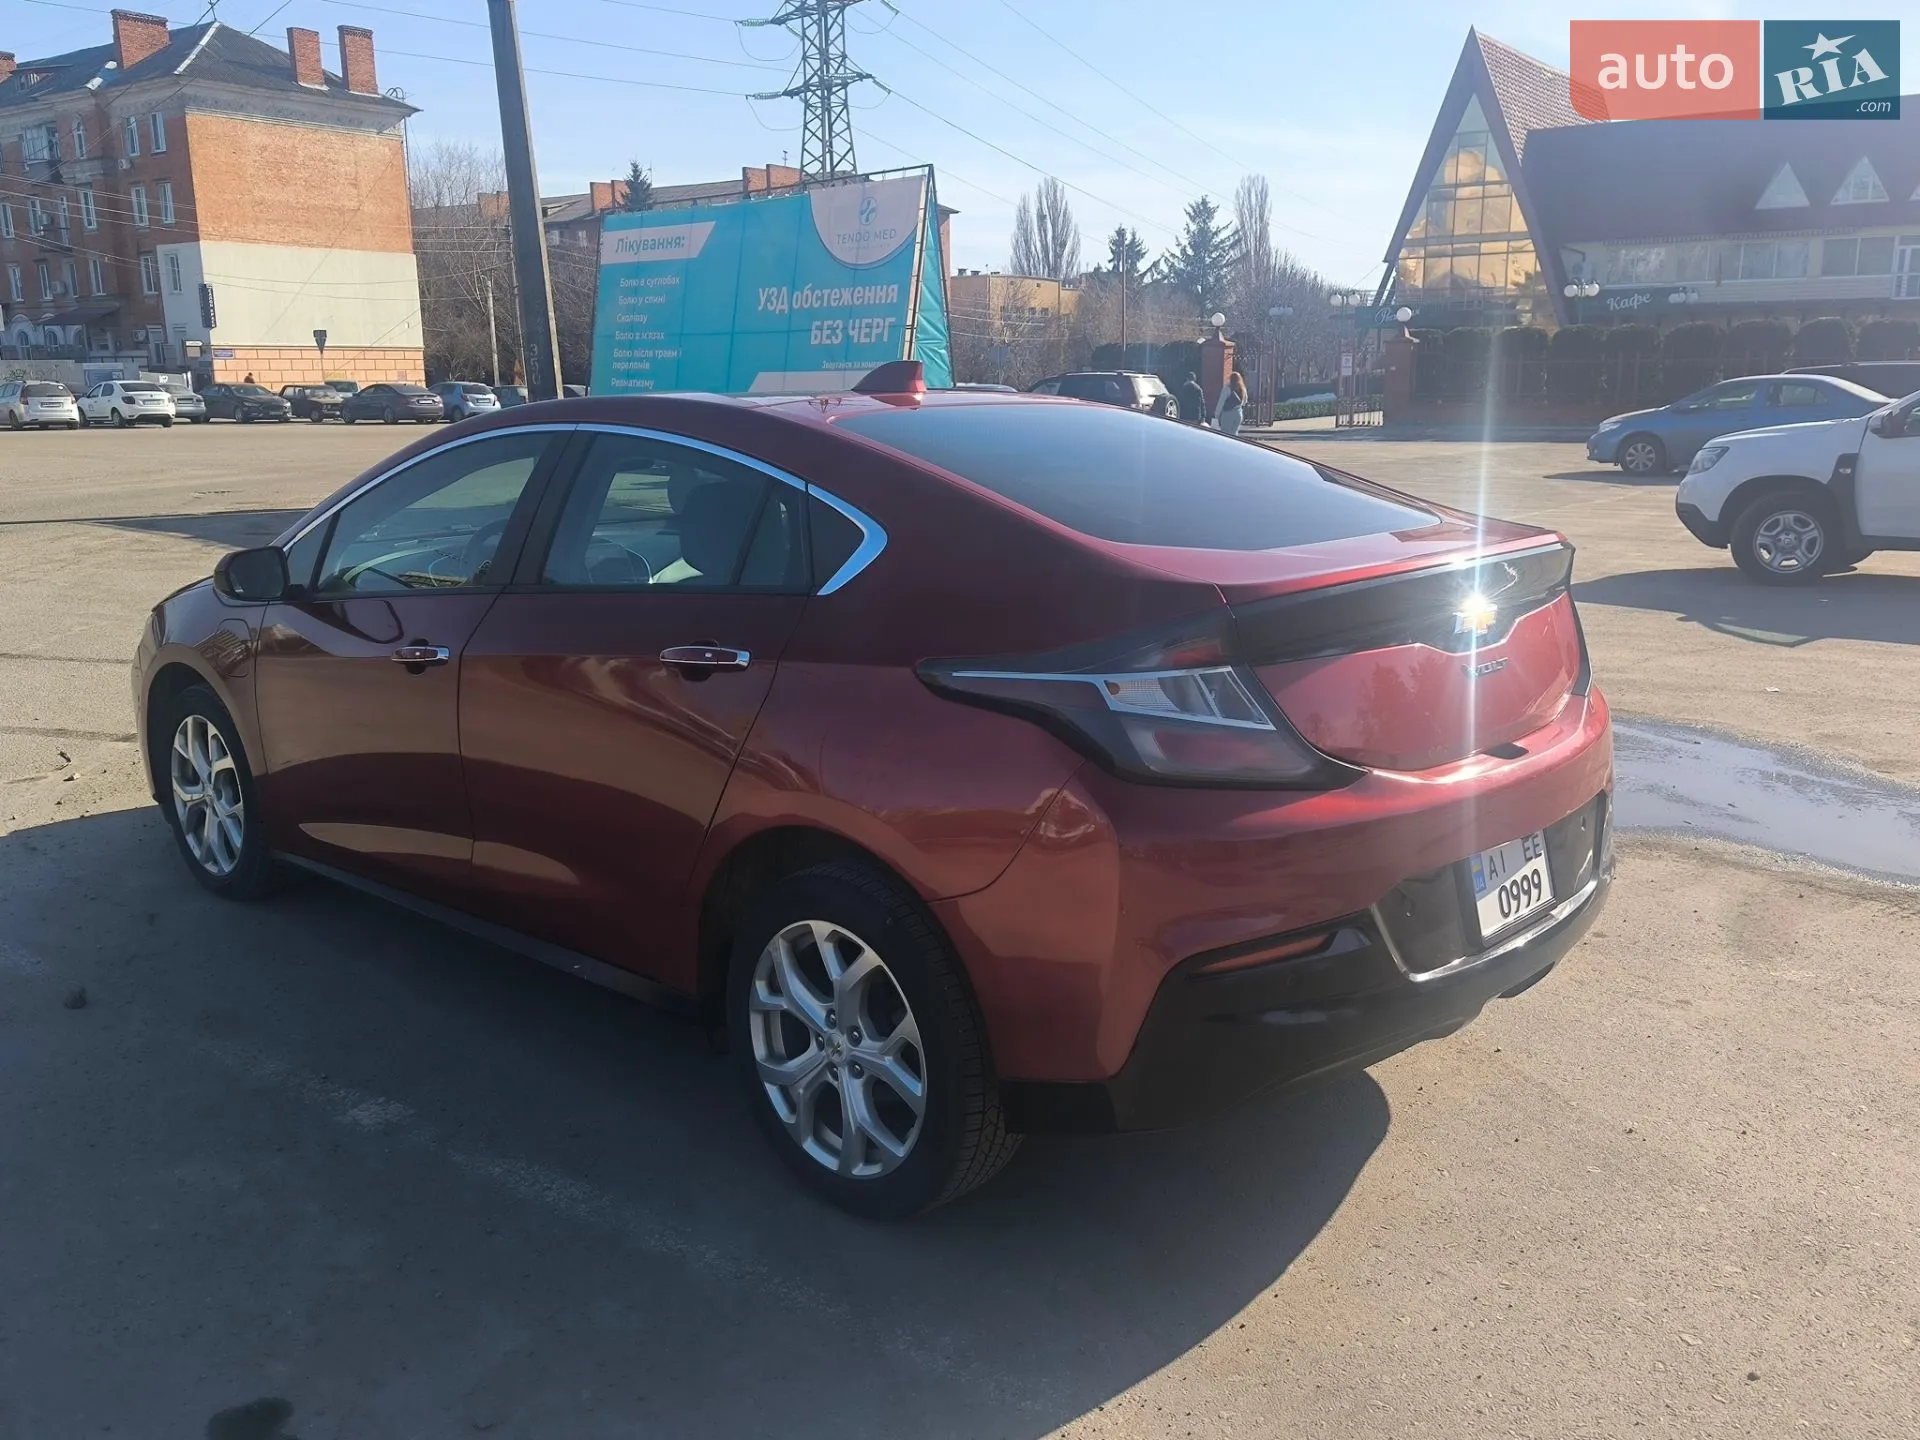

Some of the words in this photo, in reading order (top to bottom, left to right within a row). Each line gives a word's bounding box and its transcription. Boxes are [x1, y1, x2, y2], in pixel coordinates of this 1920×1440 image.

[836, 231, 870, 245] TENDO
[873, 228, 897, 241] MED
[615, 235, 685, 256] Лікування:
[619, 278, 639, 288] Болю
[646, 275, 680, 288] суглобах
[618, 295, 638, 305] Болю
[644, 294, 666, 304] спині
[758, 286, 788, 315] УЗД
[792, 283, 899, 310] обстеження
[1606, 292, 1653, 311] Кафе
[616, 313, 648, 324] Сколіозу
[615, 331, 634, 341] Болю
[810, 319, 844, 345] БЕЗ
[848, 317, 897, 344] ЧЕРГ
[613, 348, 633, 358] Болю
[1489, 850, 1506, 881] AI
[1520, 833, 1543, 863] EE
[1475, 877, 1486, 890] UA
[1497, 868, 1542, 920] 0999
